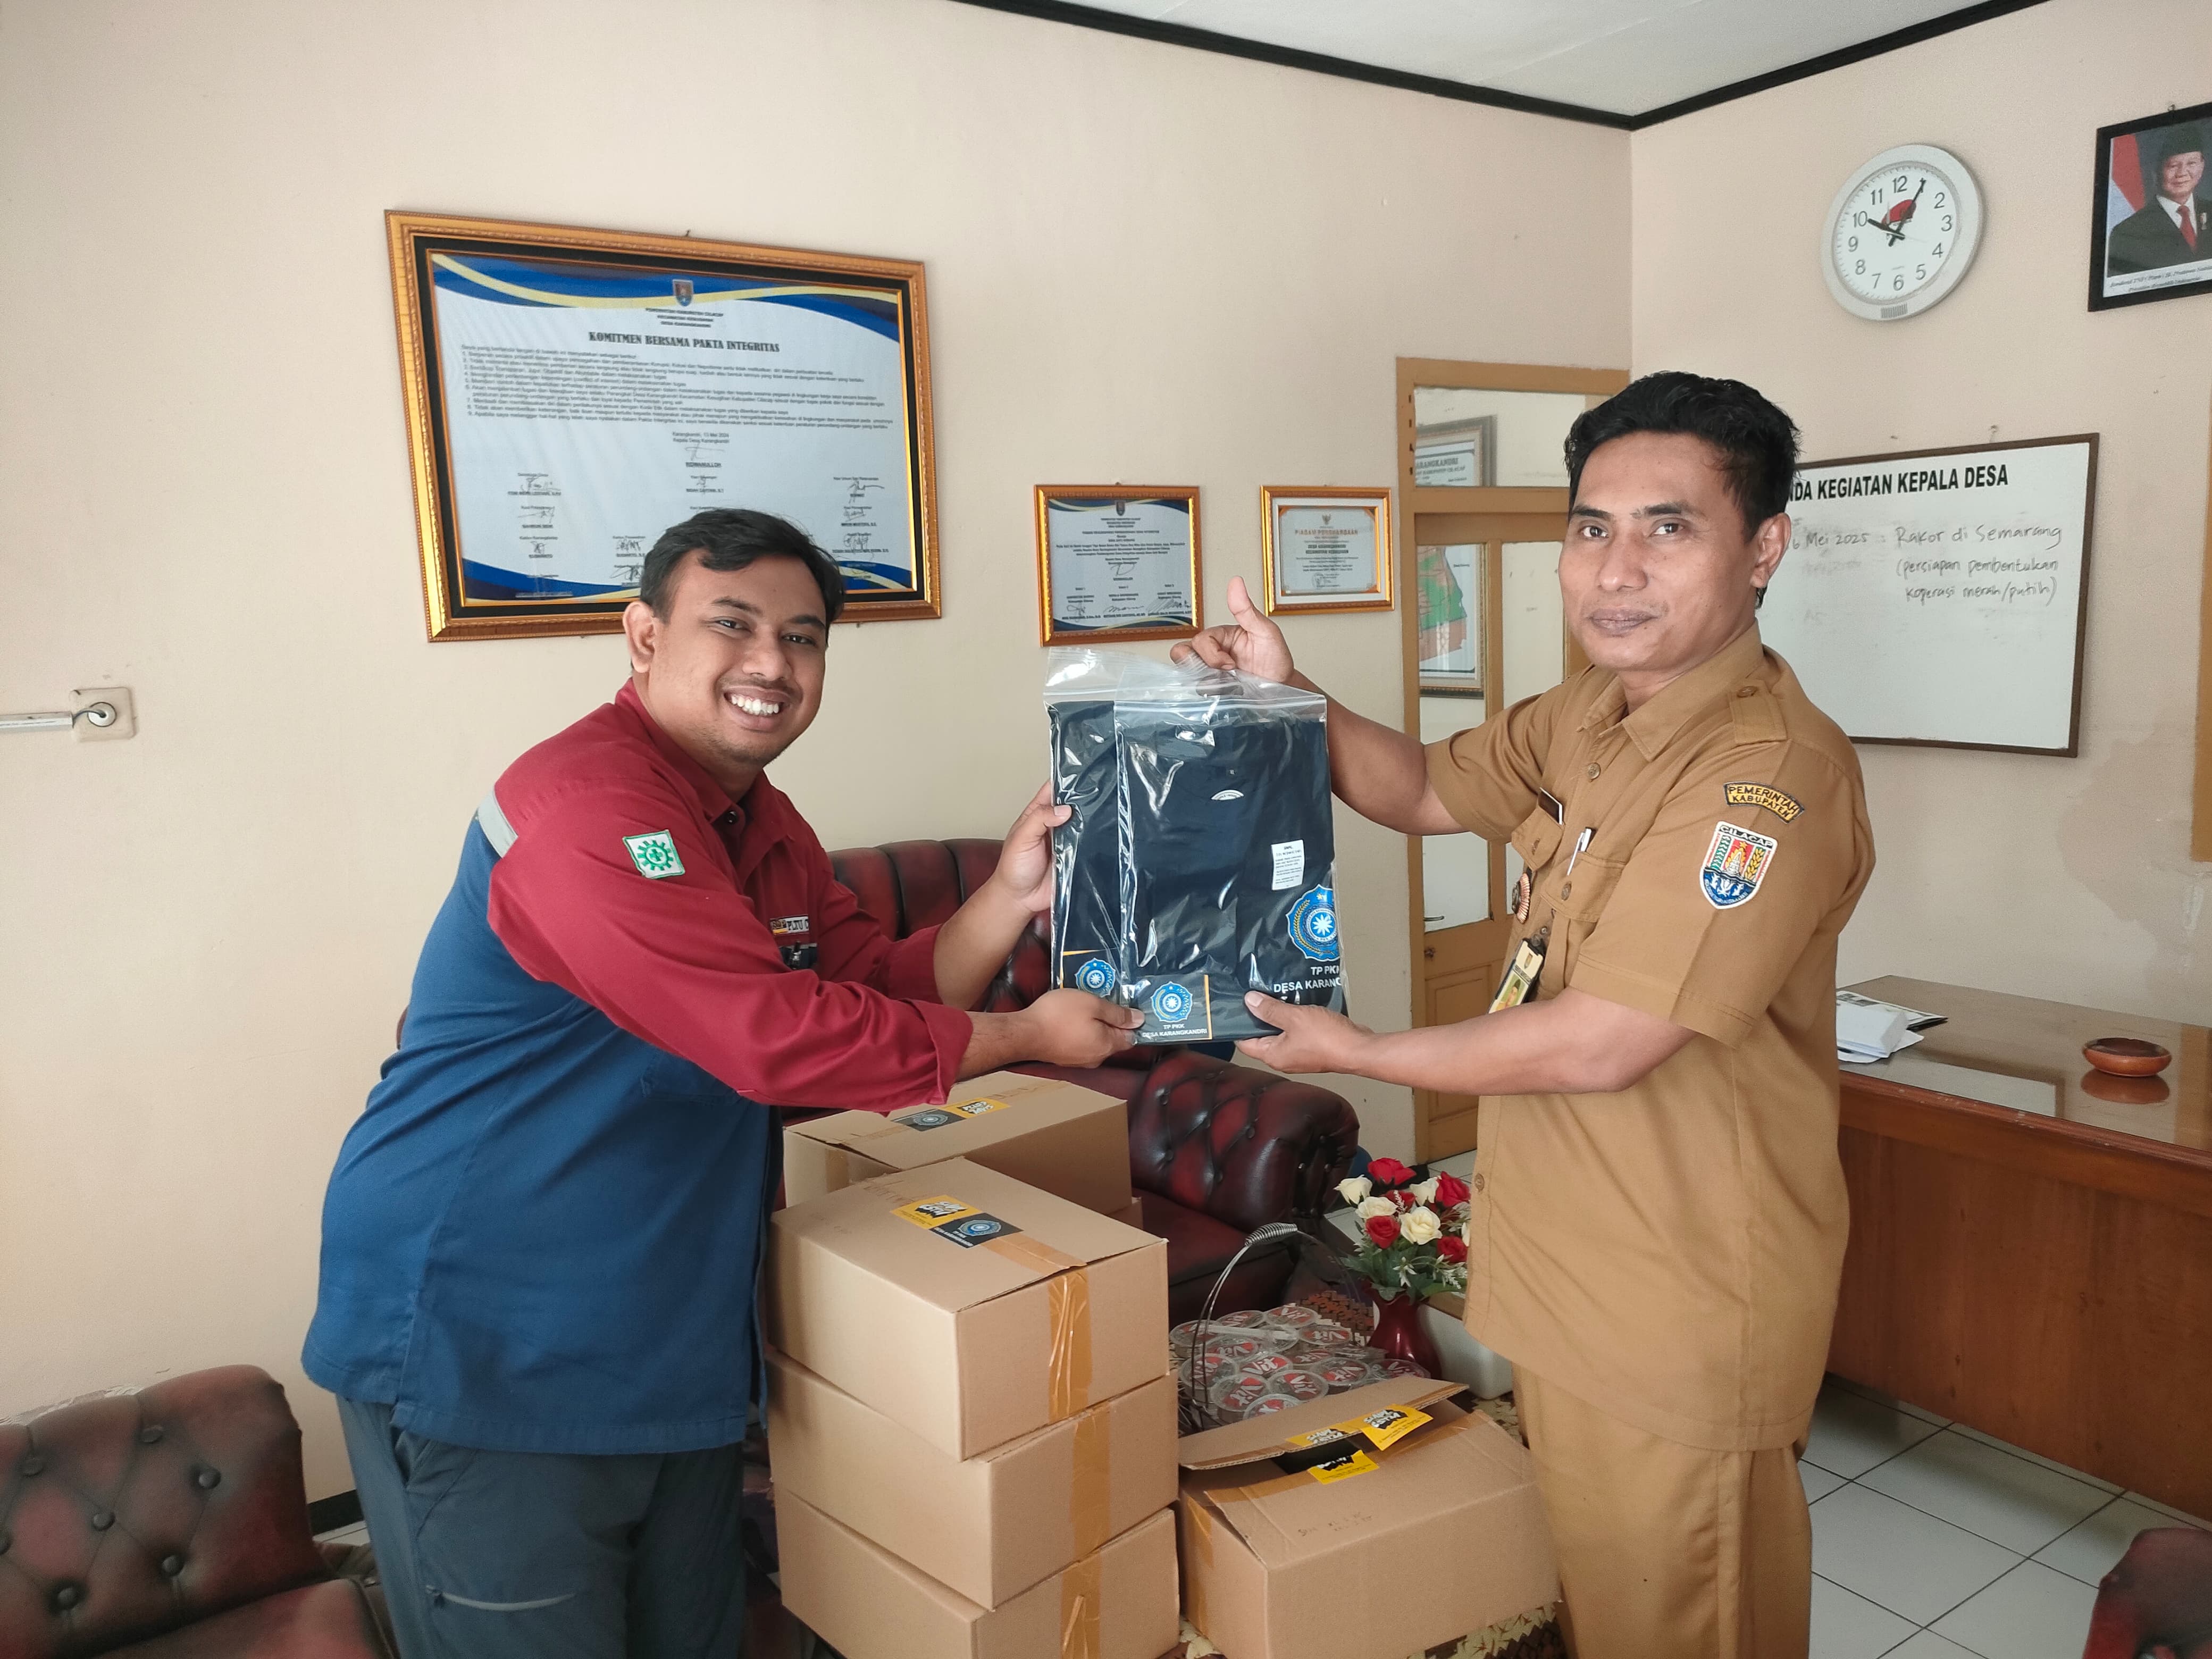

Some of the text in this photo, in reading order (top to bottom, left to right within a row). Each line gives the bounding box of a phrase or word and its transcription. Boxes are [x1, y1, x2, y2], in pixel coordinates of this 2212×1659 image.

[1892, 175, 1907, 193] 12
[1871, 188, 1883, 205] 11
[1934, 192, 1945, 209] 2
[1853, 211, 1867, 227] 10
[1941, 214, 1952, 231] 3
[1848, 236, 1858, 252] 9
[1932, 242, 1943, 258] 4
[1855, 259, 1866, 275] 8
[1915, 264, 1926, 280] 5
[1872, 273, 1882, 289] 7
[1892, 274, 1904, 291] 6
[589, 332, 780, 352] KOMITMEN BERSAMA PAKTA INTEGRITAS
[1789, 464, 2008, 501] DA KEGIATAN KEPALA DESA
[1806, 532, 1829, 548] Mei
[1835, 533, 1869, 545] 2025
[1895, 526, 1945, 549] Rakor
[1951, 527, 1967, 542] di
[1975, 524, 2063, 551] Semarang
[1728, 786, 1800, 815] PEMERINTAH
[1732, 795, 1790, 817] KABUPATEN
[1719, 825, 1773, 847] CILACAP
[787, 920, 803, 931] PLTU
[1311, 966, 1323, 975] TP
[1273, 981, 1303, 993] DESA
[1159, 1028, 1207, 1037] KARANGKANDRI
[1281, 1308, 1311, 1320] Vit
[1312, 1331, 1346, 1340] Vit
[1242, 1357, 1278, 1375] Vit
[1290, 1375, 1318, 1394] Vit
[1230, 1385, 1264, 1406] Vit
